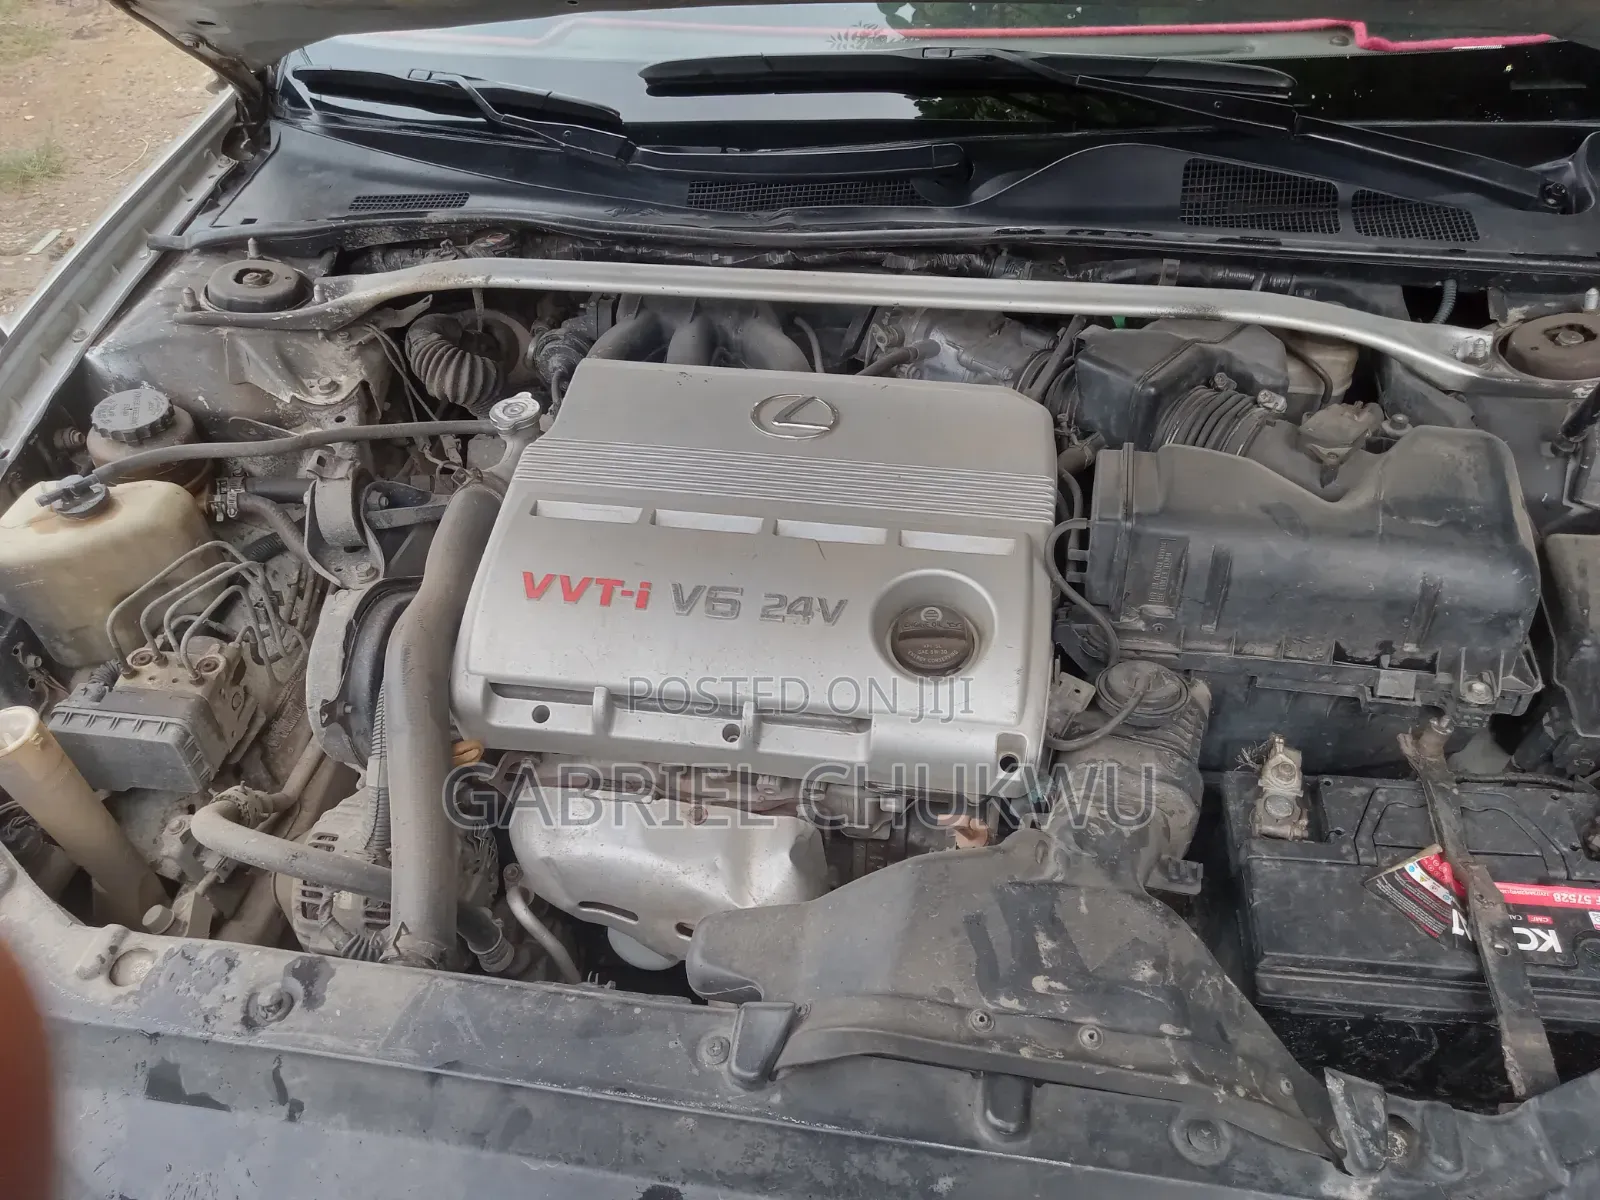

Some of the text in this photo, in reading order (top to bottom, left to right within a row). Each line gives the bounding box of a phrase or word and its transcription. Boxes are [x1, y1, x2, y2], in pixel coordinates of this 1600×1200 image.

[522, 571, 848, 626] VVT-i V6 24V
[1553, 892, 1592, 905] 57528
